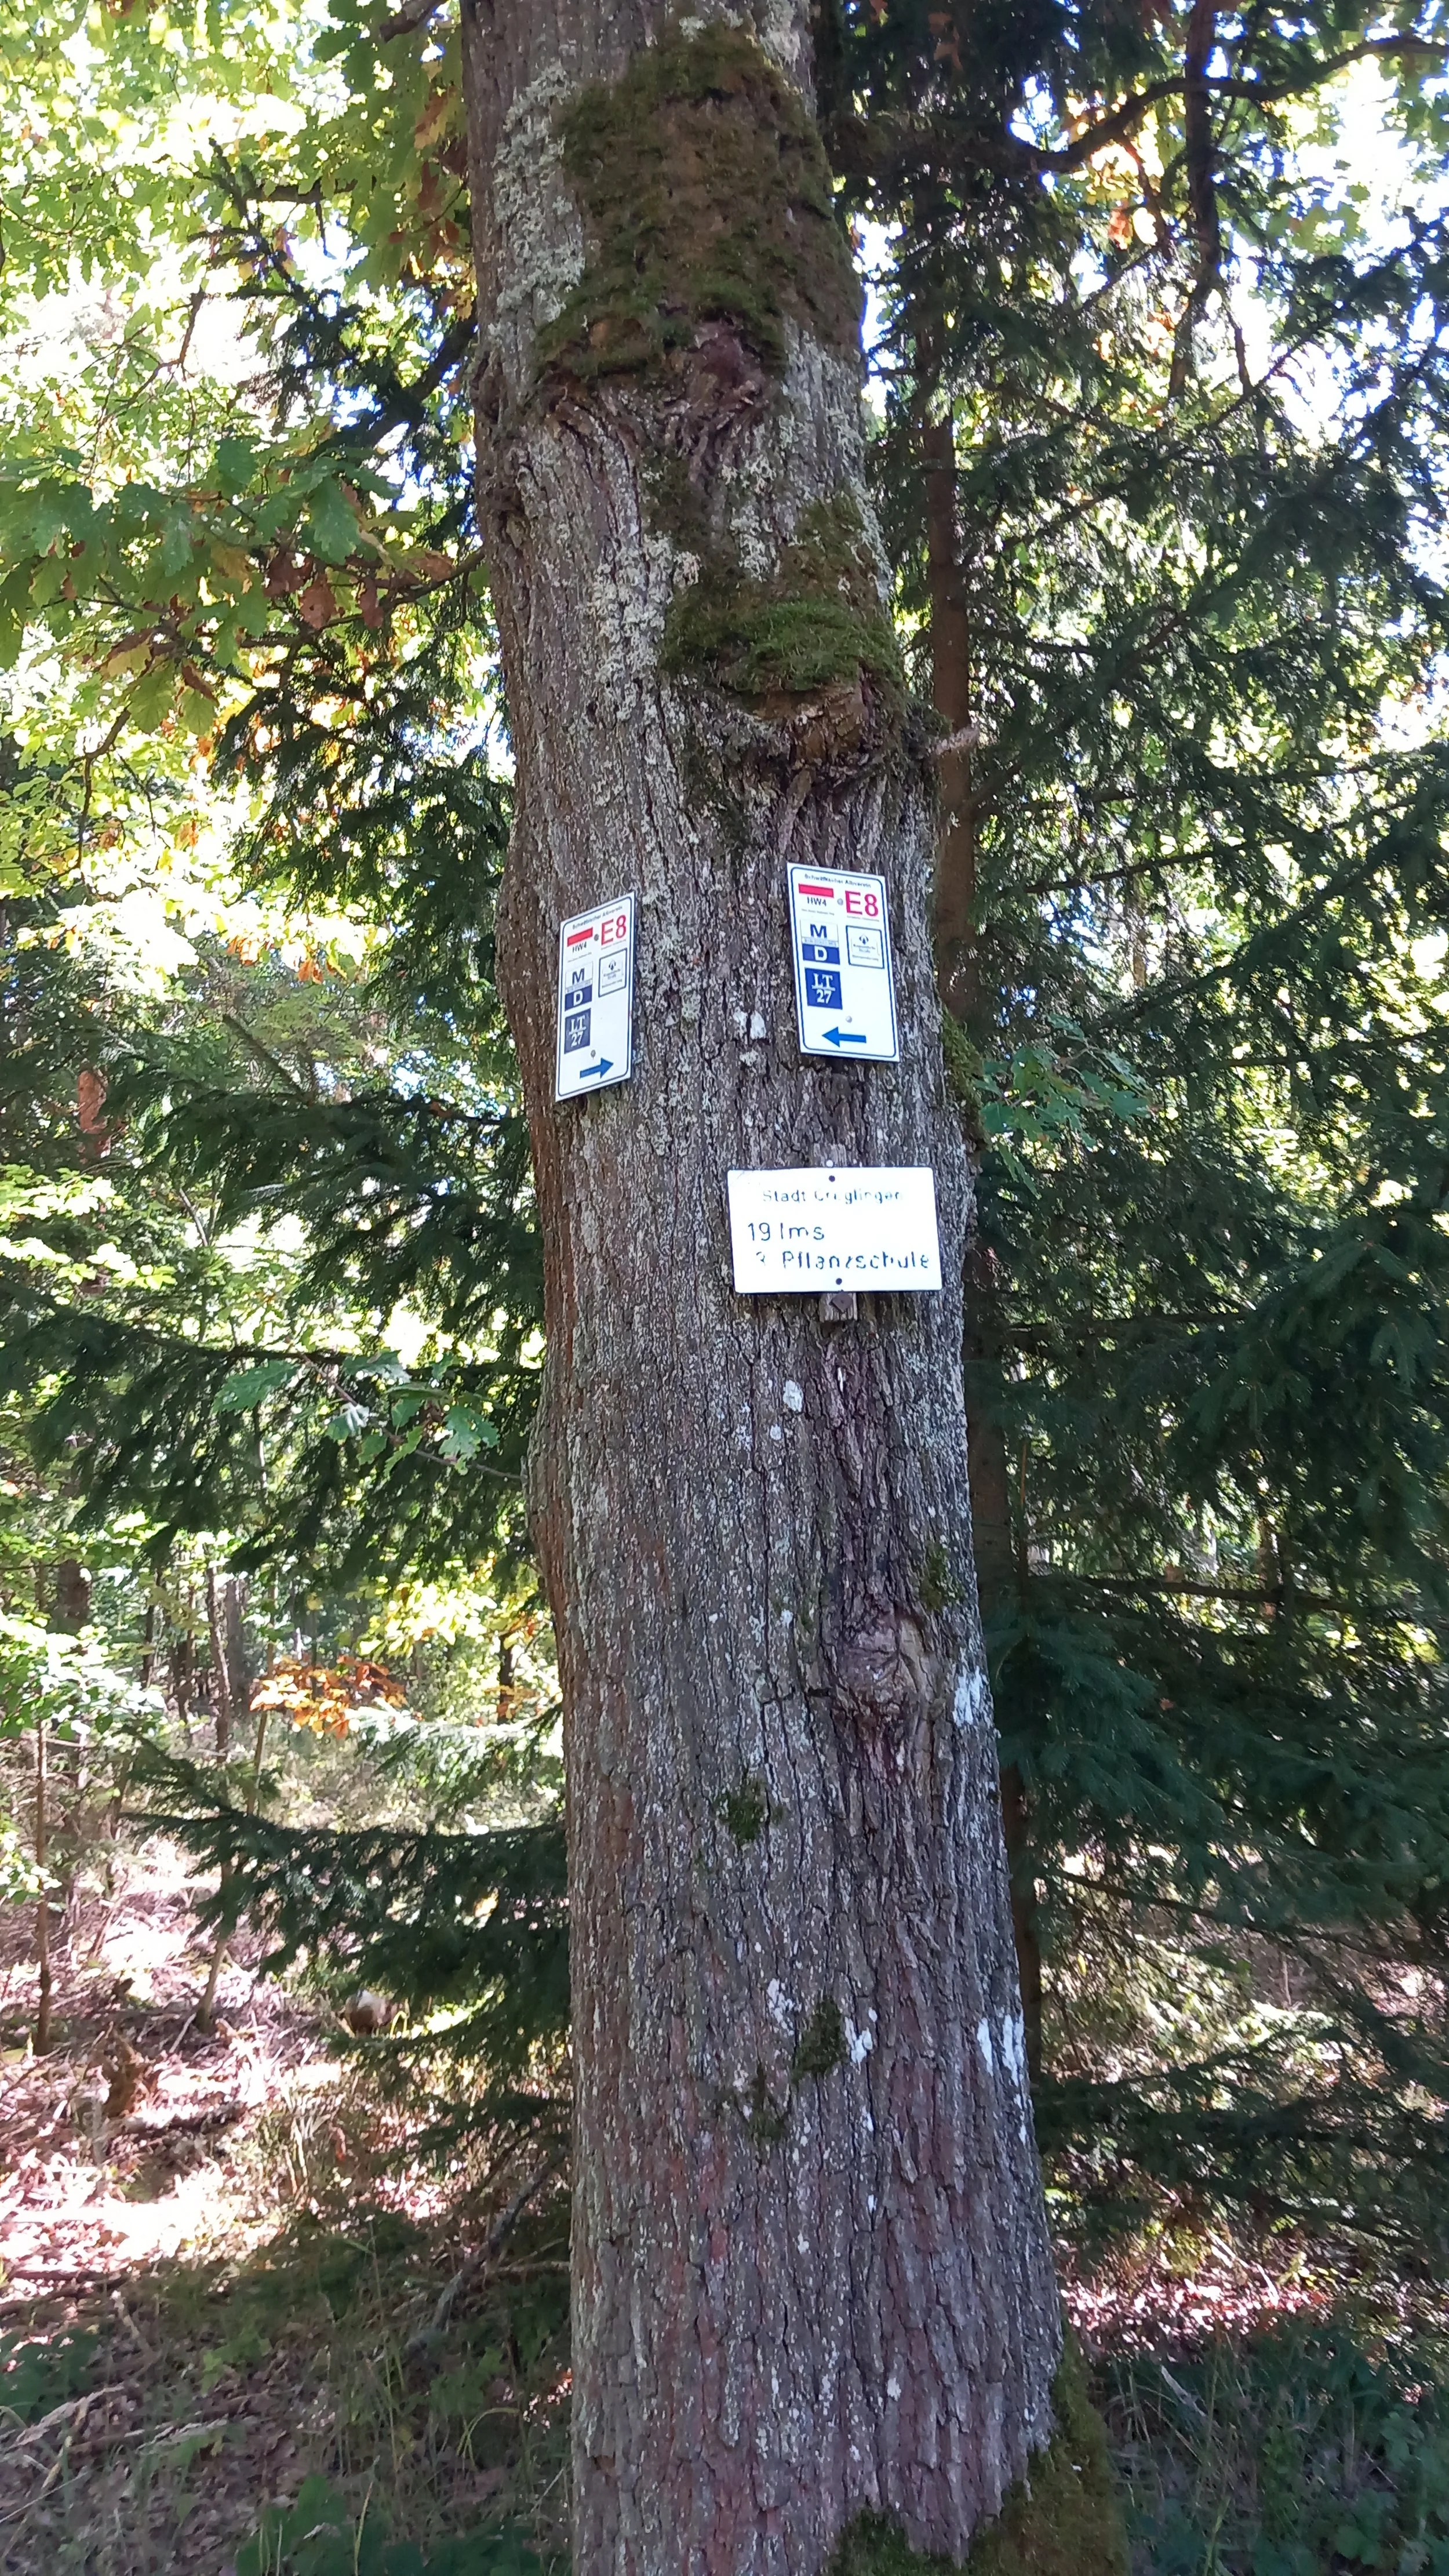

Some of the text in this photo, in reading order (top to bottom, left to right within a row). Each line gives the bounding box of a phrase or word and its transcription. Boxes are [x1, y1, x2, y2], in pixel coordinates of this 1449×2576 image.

[807, 896, 827, 907] HW4
[845, 890, 879, 917] E8
[601, 914, 627, 946] E8
[810, 924, 827, 939] M
[573, 941, 587, 953] HW4
[814, 946, 828, 961] D
[572, 967, 585, 985] M
[813, 973, 835, 989] LT
[573, 990, 583, 1007] D
[816, 989, 832, 1004] 27
[570, 1015, 586, 1034] LT
[571, 1031, 584, 1048] 27
[763, 1189, 806, 1203] Stadt
[748, 1222, 771, 1241] 19
